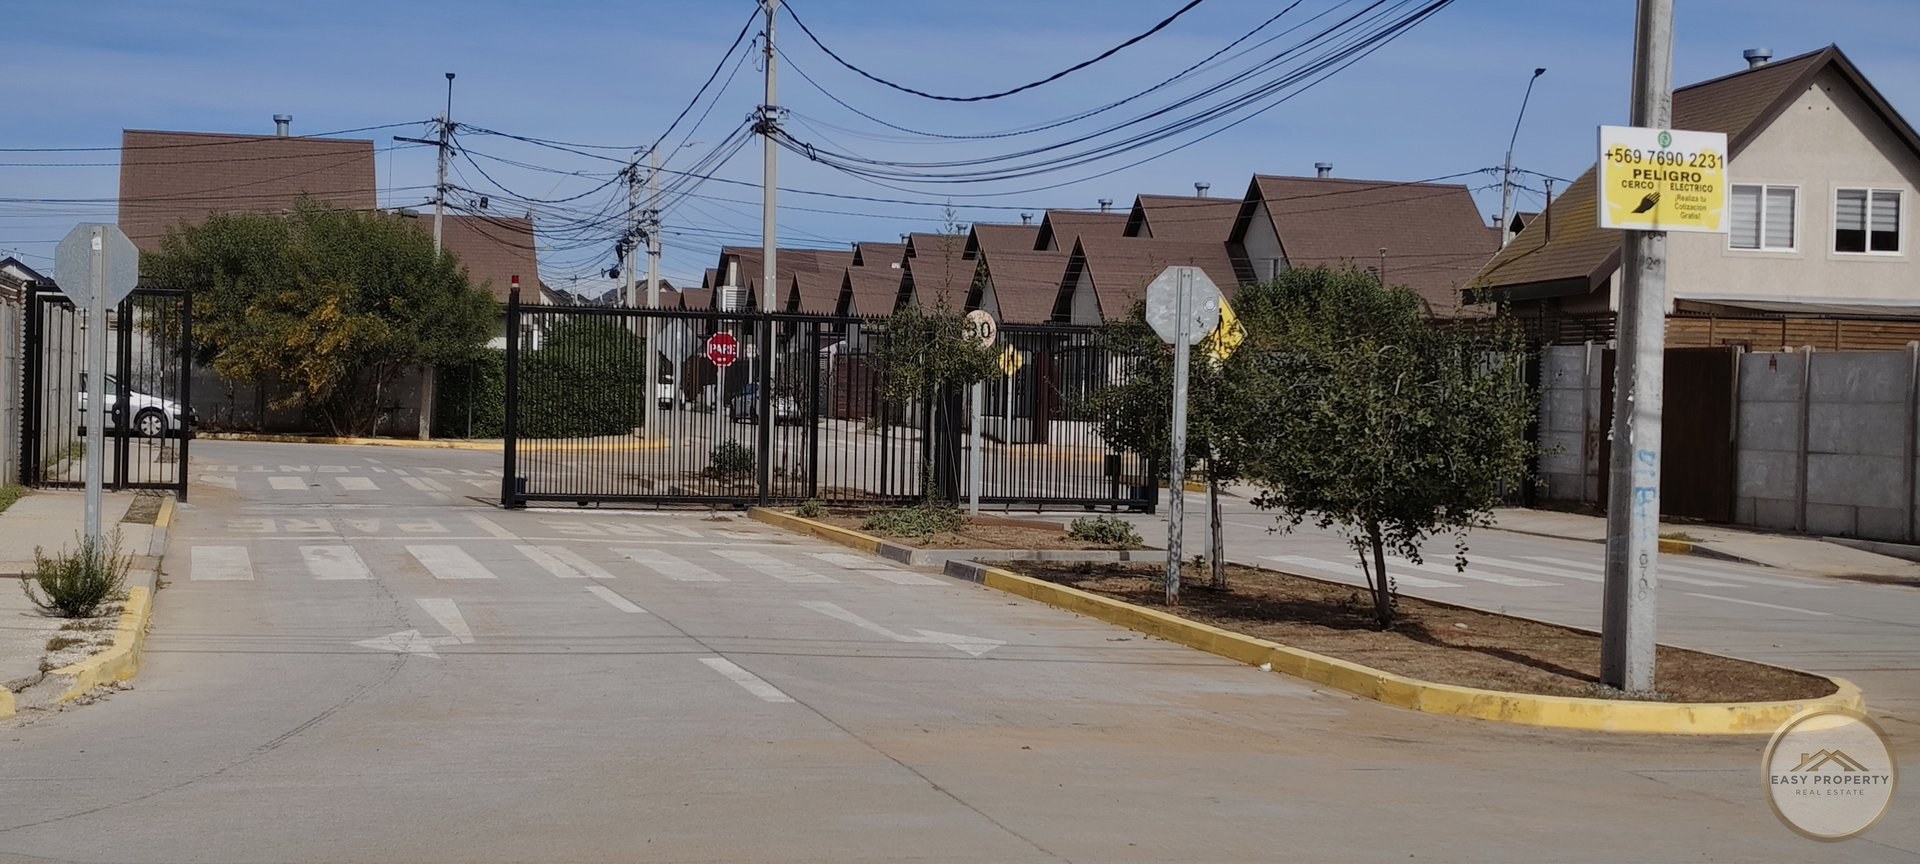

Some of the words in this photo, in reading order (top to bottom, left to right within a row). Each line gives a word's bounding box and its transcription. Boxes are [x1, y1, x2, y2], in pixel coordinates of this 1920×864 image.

[1605, 148, 1642, 164] +569
[1647, 150, 1684, 167] 7690
[1689, 152, 1724, 169] 2231
[1633, 169, 1702, 183] PELIGRO
[1621, 180, 1655, 190] CERCO
[1670, 182, 1713, 193] ELECTRICO
[964, 321, 990, 338] 30
[709, 343, 737, 355] PARE
[227, 518, 451, 533] PARE
